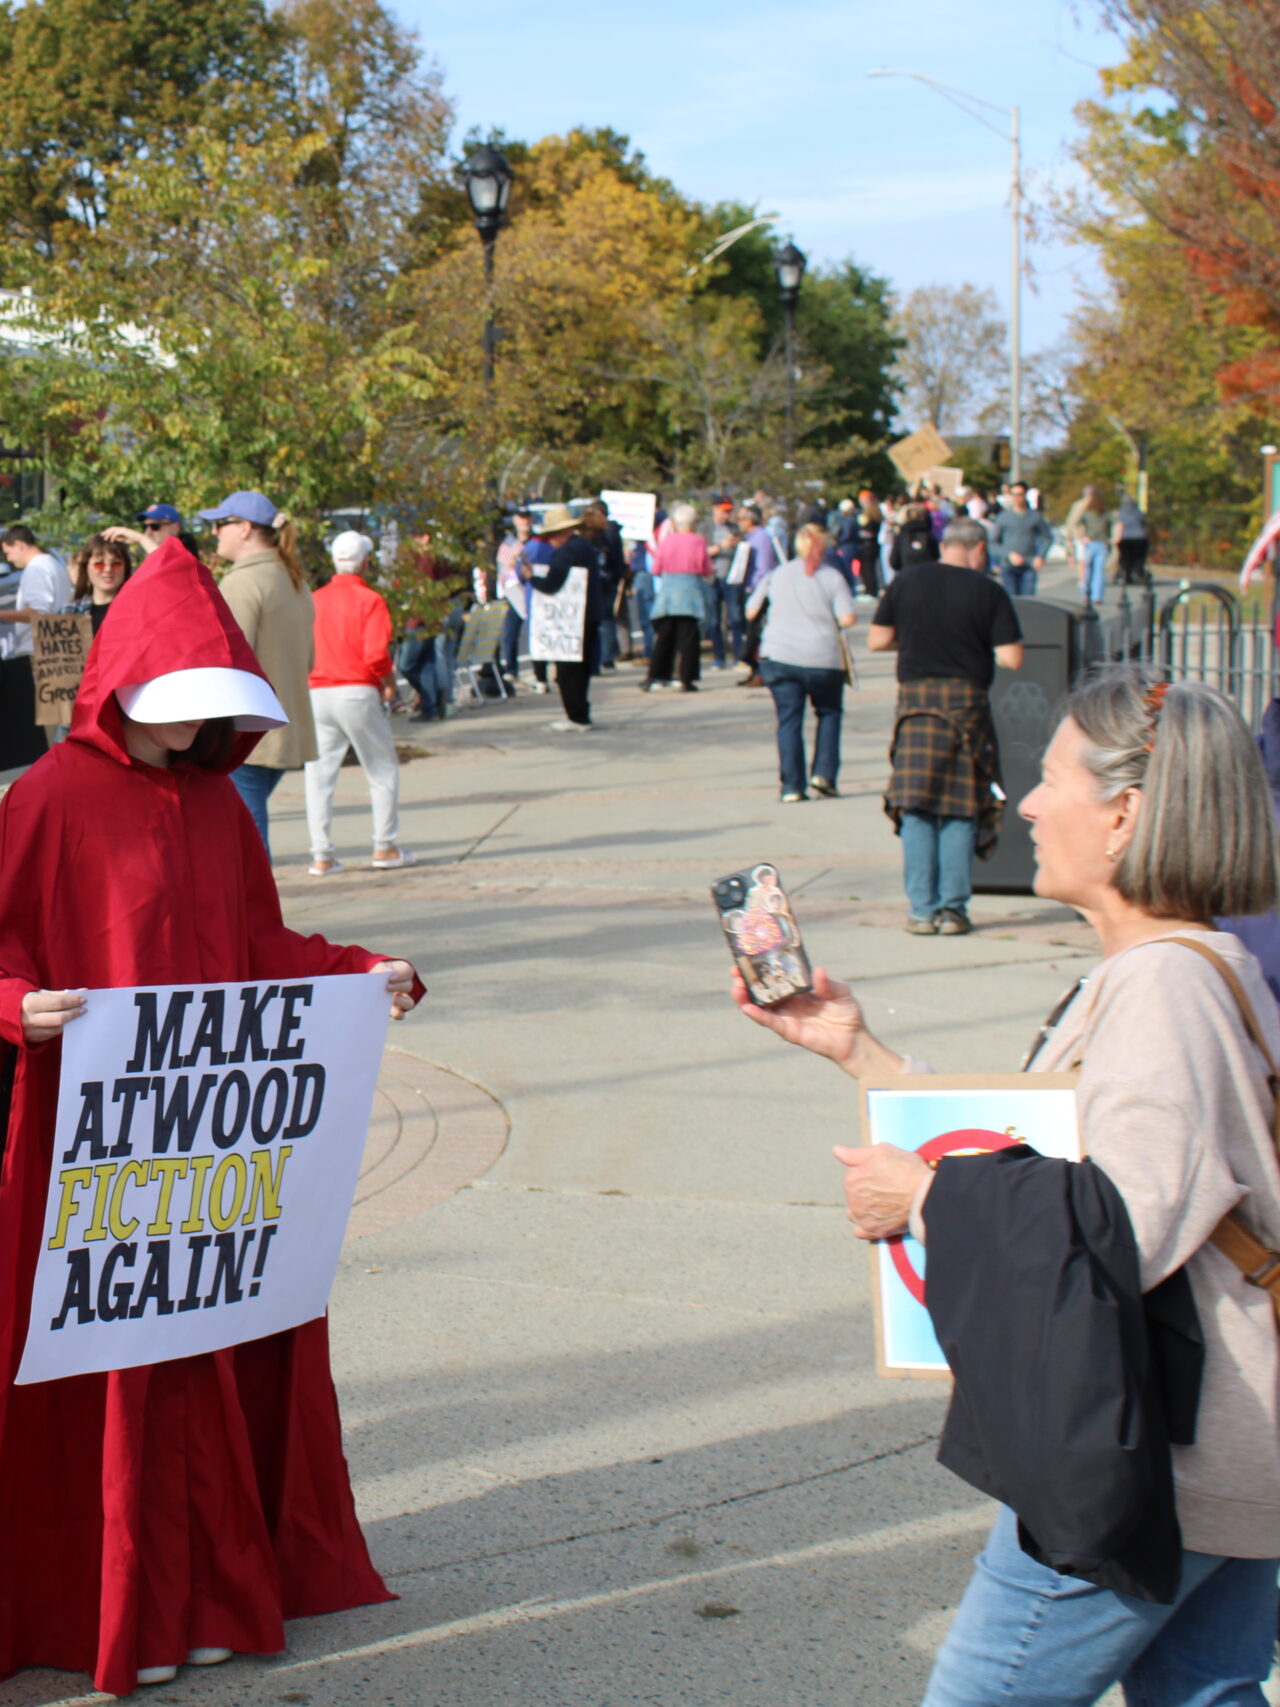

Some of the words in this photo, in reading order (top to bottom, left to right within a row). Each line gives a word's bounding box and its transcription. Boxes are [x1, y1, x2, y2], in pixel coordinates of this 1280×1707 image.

[38, 619, 80, 638] MAGA
[40, 639, 83, 656] HATES
[126, 984, 314, 1073] MAKE
[62, 1063, 326, 1164] ATWOOD
[47, 1145, 293, 1250] FICTION
[50, 1224, 278, 1331] AGAIN!
